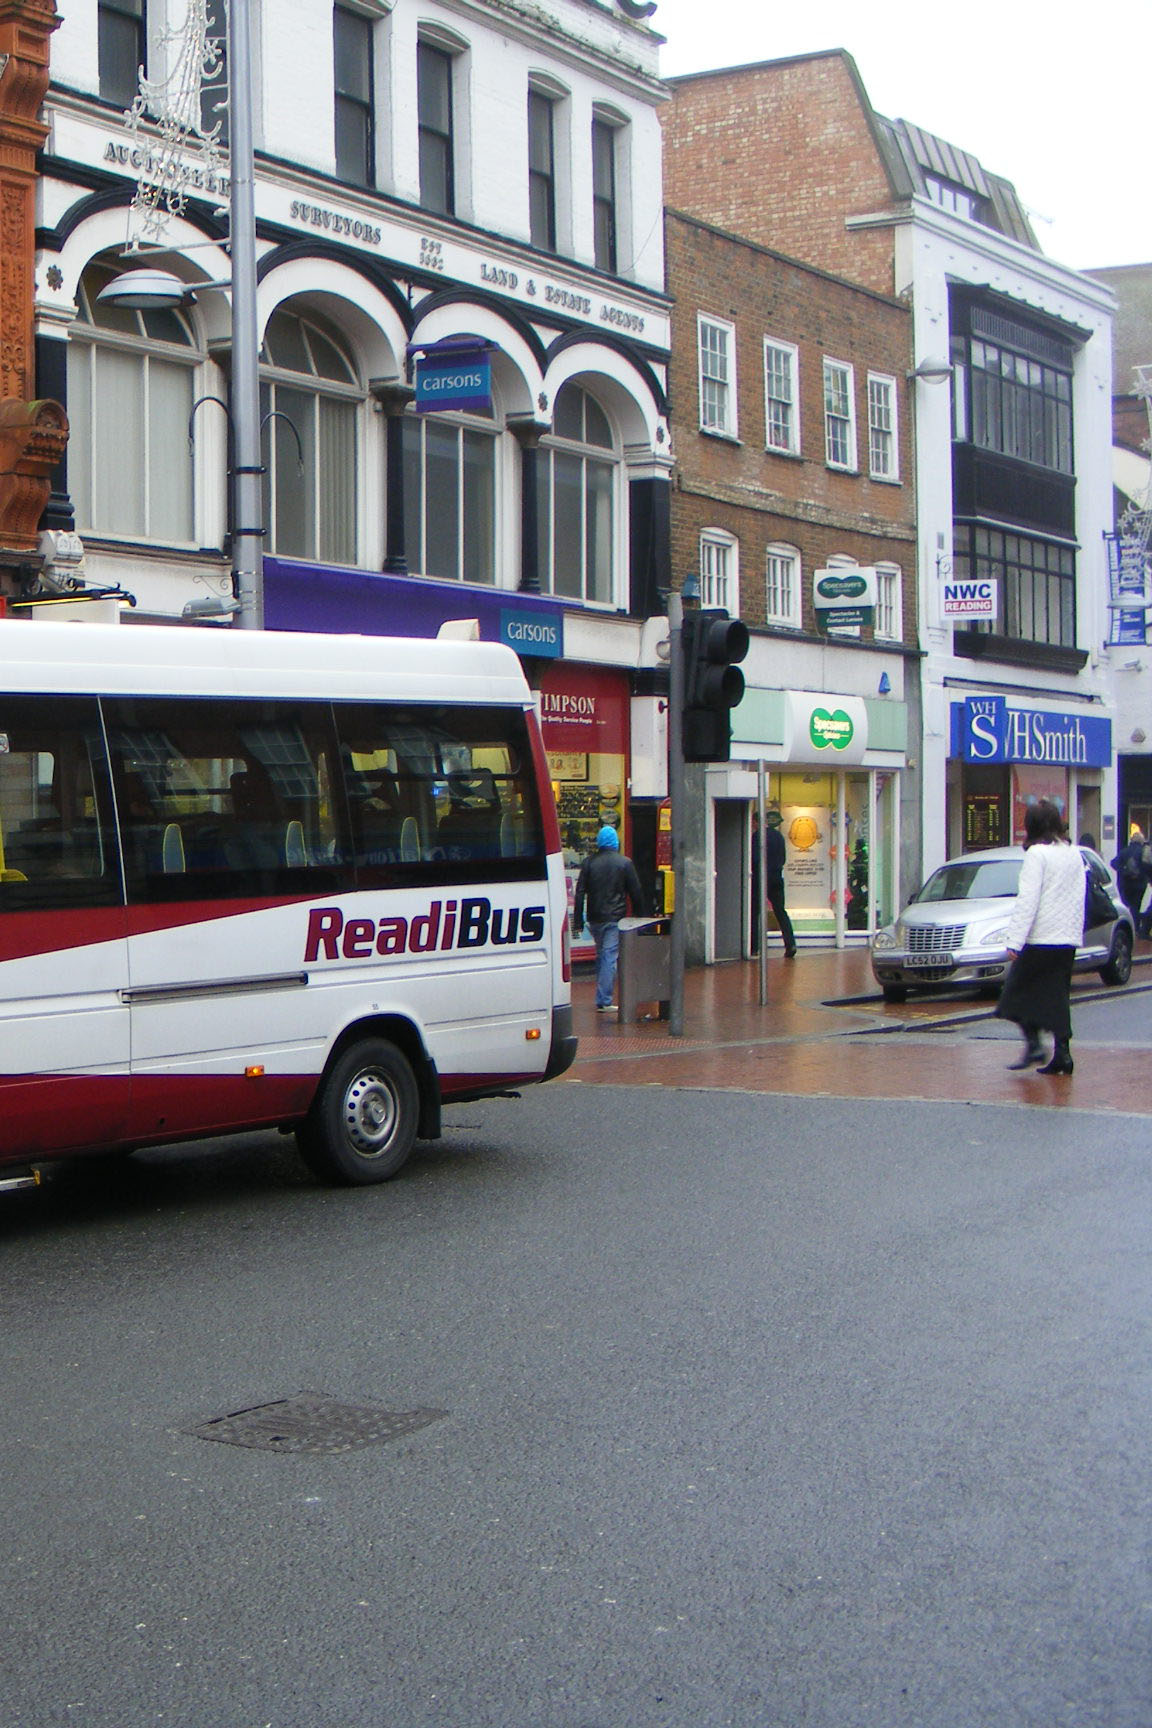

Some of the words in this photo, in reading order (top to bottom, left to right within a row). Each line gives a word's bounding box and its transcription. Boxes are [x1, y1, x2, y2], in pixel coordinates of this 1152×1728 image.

[290, 200, 383, 245] SURVEYORS
[480, 263, 519, 290] LAND
[526, 279, 537, 297] &
[544, 285, 592, 315] ESTATE
[599, 304, 646, 333] AGENTS
[422, 371, 482, 392] carsons
[944, 583, 991, 600] NWC
[945, 600, 992, 612] READING
[507, 621, 557, 645] carsons
[541, 692, 595, 714] IMPSON
[970, 702, 996, 714] WH
[814, 716, 850, 732] Specsavers
[970, 714, 998, 758] S
[304, 897, 546, 962] ReadiBus
